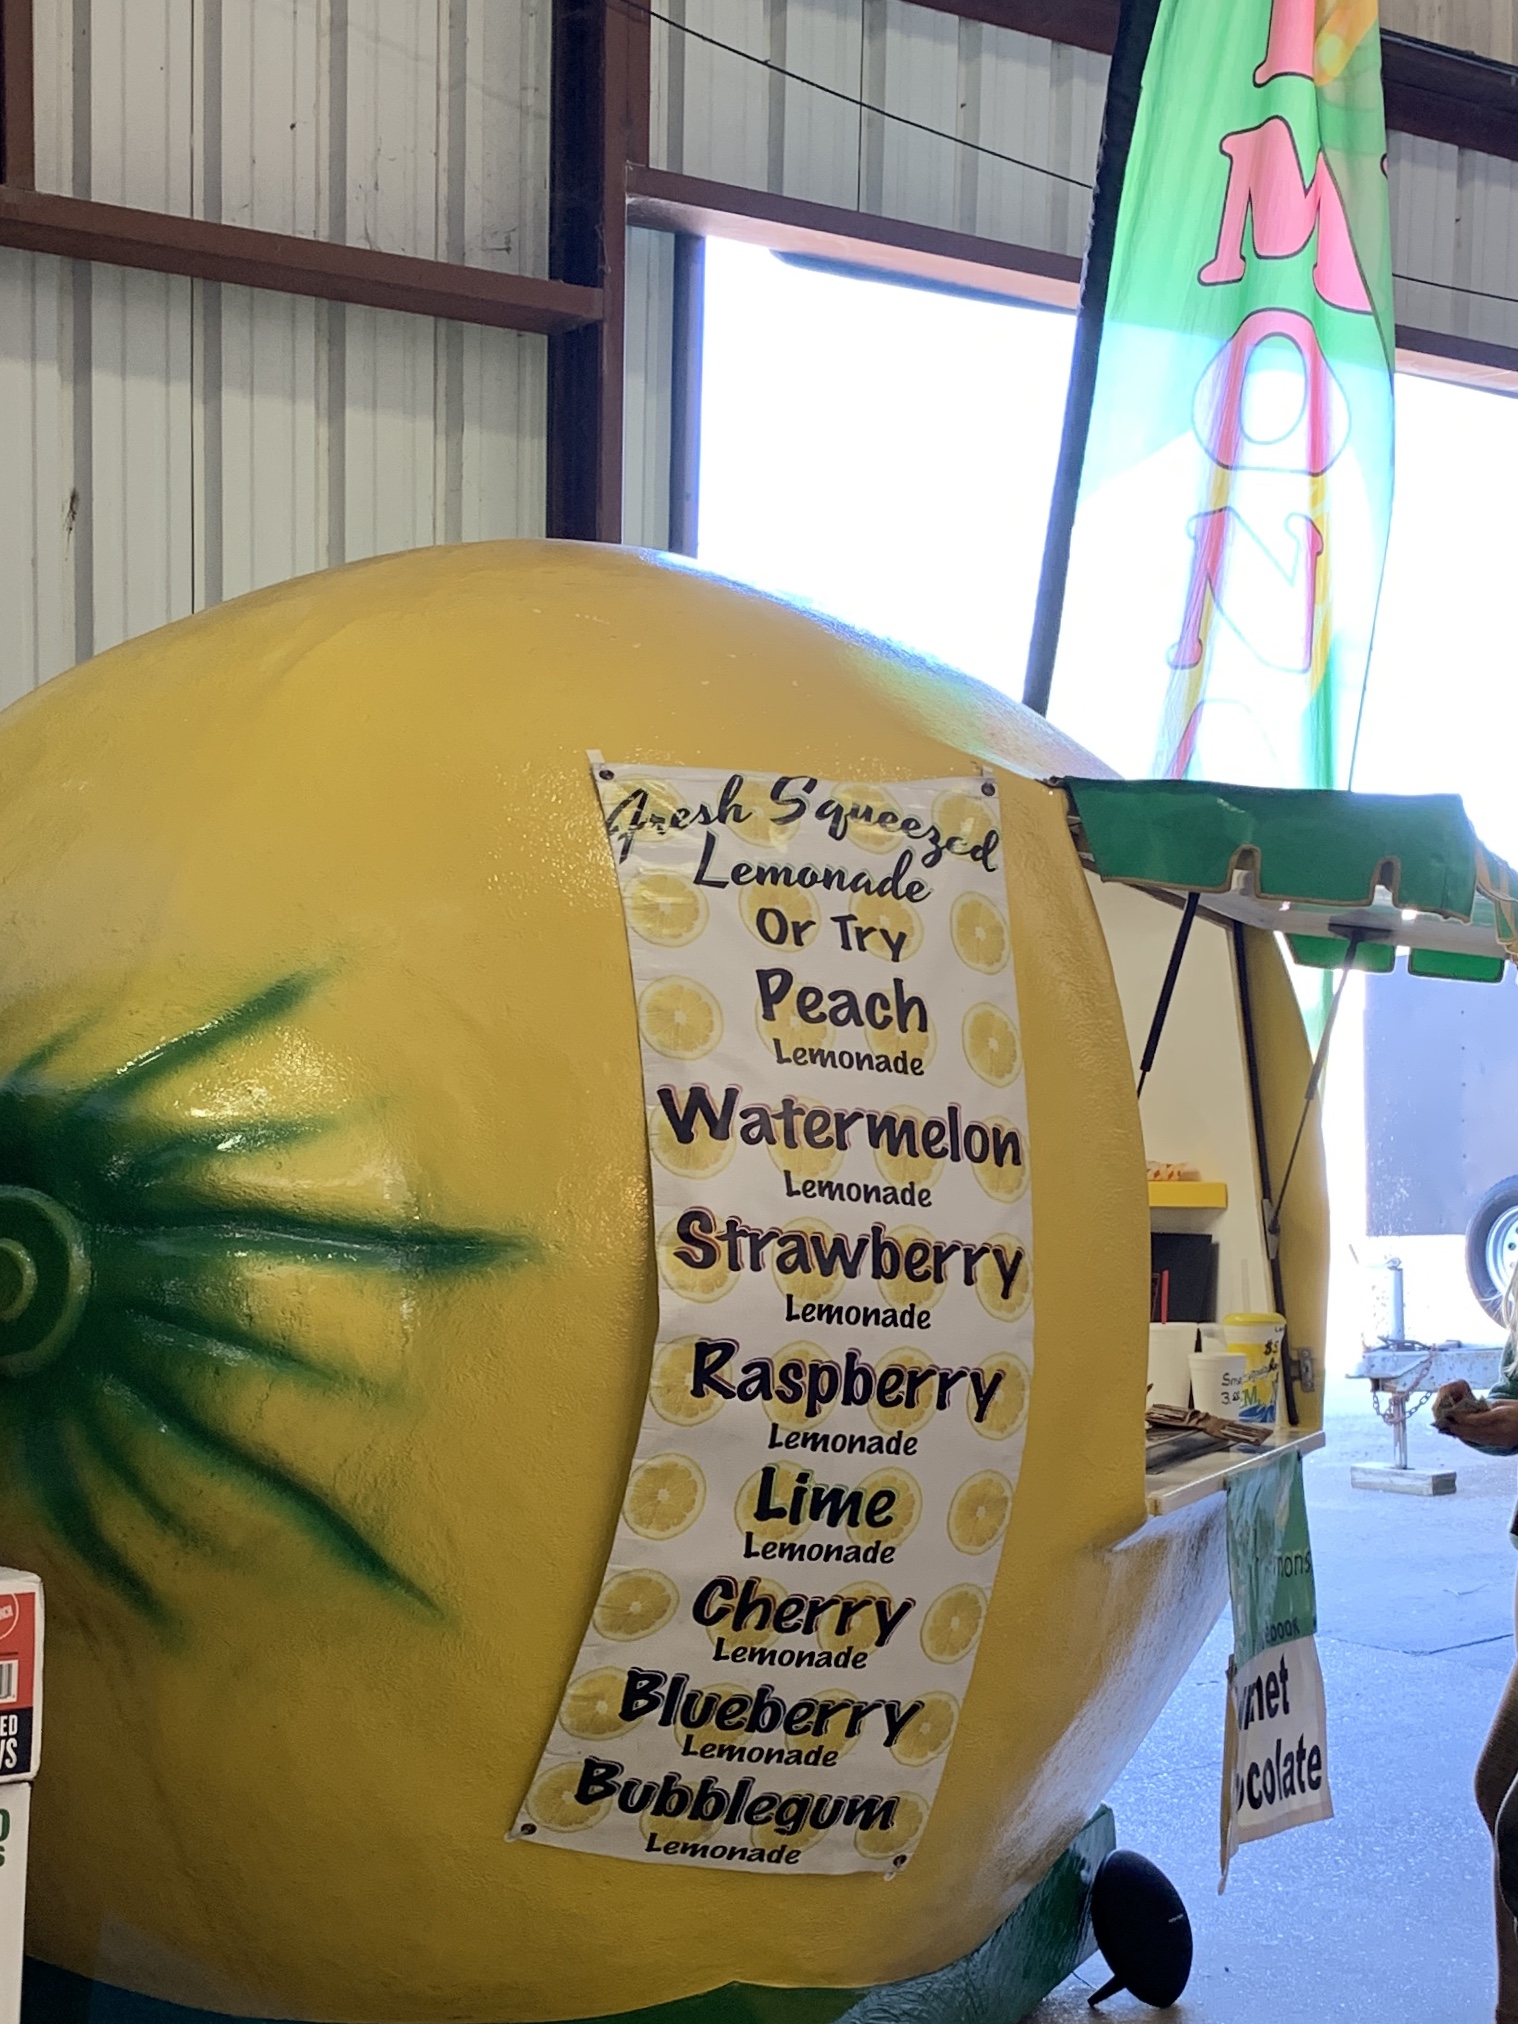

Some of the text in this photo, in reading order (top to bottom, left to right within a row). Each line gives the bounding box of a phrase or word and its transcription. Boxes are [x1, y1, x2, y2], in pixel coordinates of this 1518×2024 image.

[605, 774, 1001, 873] Fresh Squeezed
[692, 831, 932, 903] Lemonade
[755, 907, 908, 963] Or Try
[755, 967, 929, 1035] Peach
[772, 1038, 926, 1077] Lemonade
[656, 1084, 1024, 1168] Watermelon
[783, 1169, 933, 1208] Lemonade
[673, 1206, 1025, 1300] Strawberry
[785, 1294, 932, 1330] Lemonade
[689, 1337, 1007, 1423] Raspberry
[767, 1422, 919, 1457] Lemonade
[753, 1463, 898, 1529] Lime
[743, 1531, 897, 1565] Lemonade
[691, 1575, 916, 1648] Cherry
[712, 1637, 869, 1670] Lemonade
[618, 1666, 925, 1747] Blueberry
[681, 1734, 839, 1768] Lemonade
[573, 1755, 901, 1836] Bubblegum
[644, 1832, 803, 1865] Lemonade
